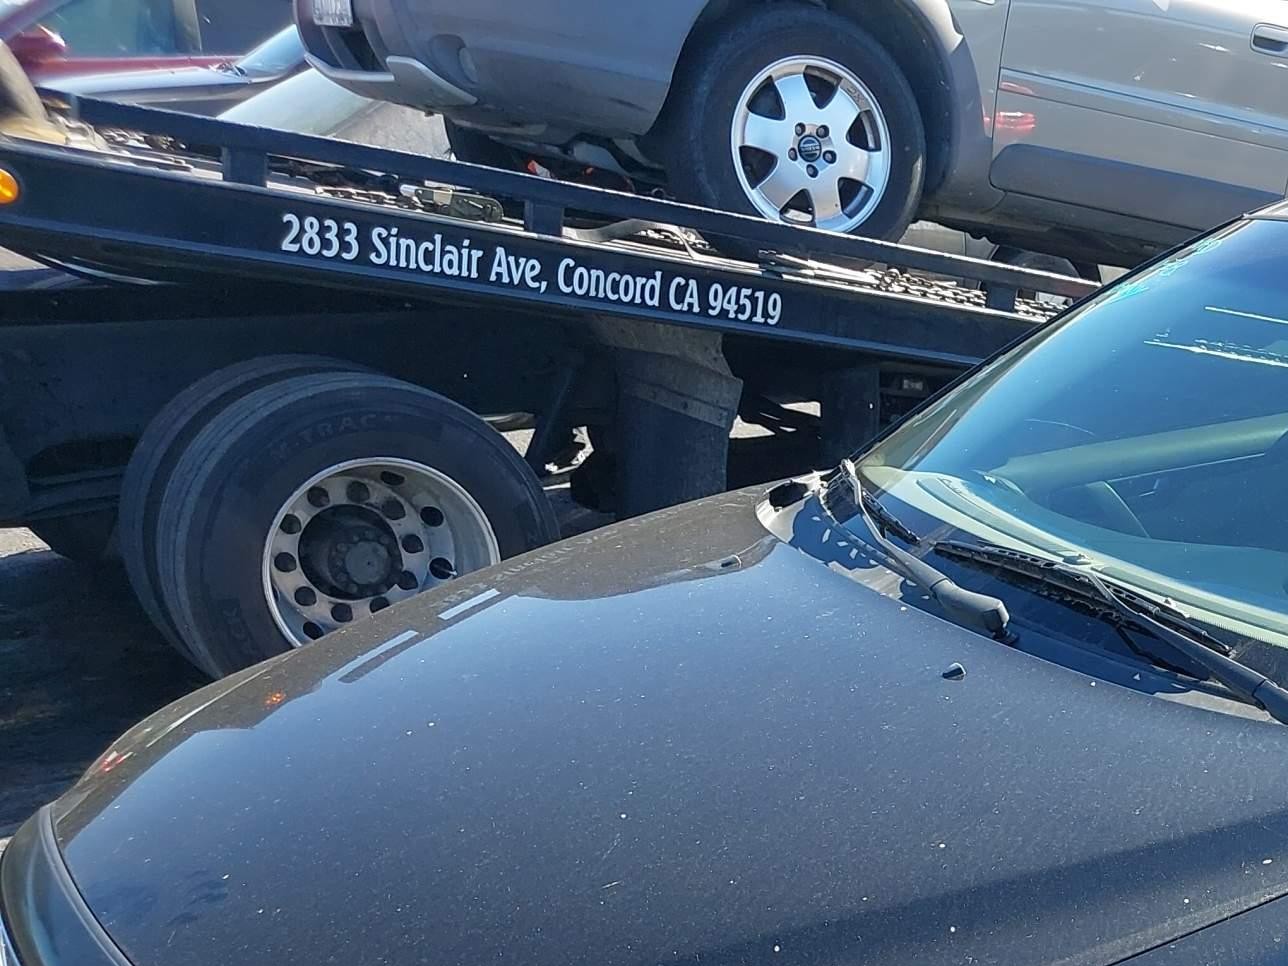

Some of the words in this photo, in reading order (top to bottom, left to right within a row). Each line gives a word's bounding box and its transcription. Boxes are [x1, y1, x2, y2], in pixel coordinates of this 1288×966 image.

[281, 213, 360, 261] 2833
[369, 227, 483, 279] Sinclair
[489, 246, 547, 293] Ave,
[558, 258, 662, 307] Concord
[669, 276, 700, 313] CA
[708, 283, 782, 326] 94519
